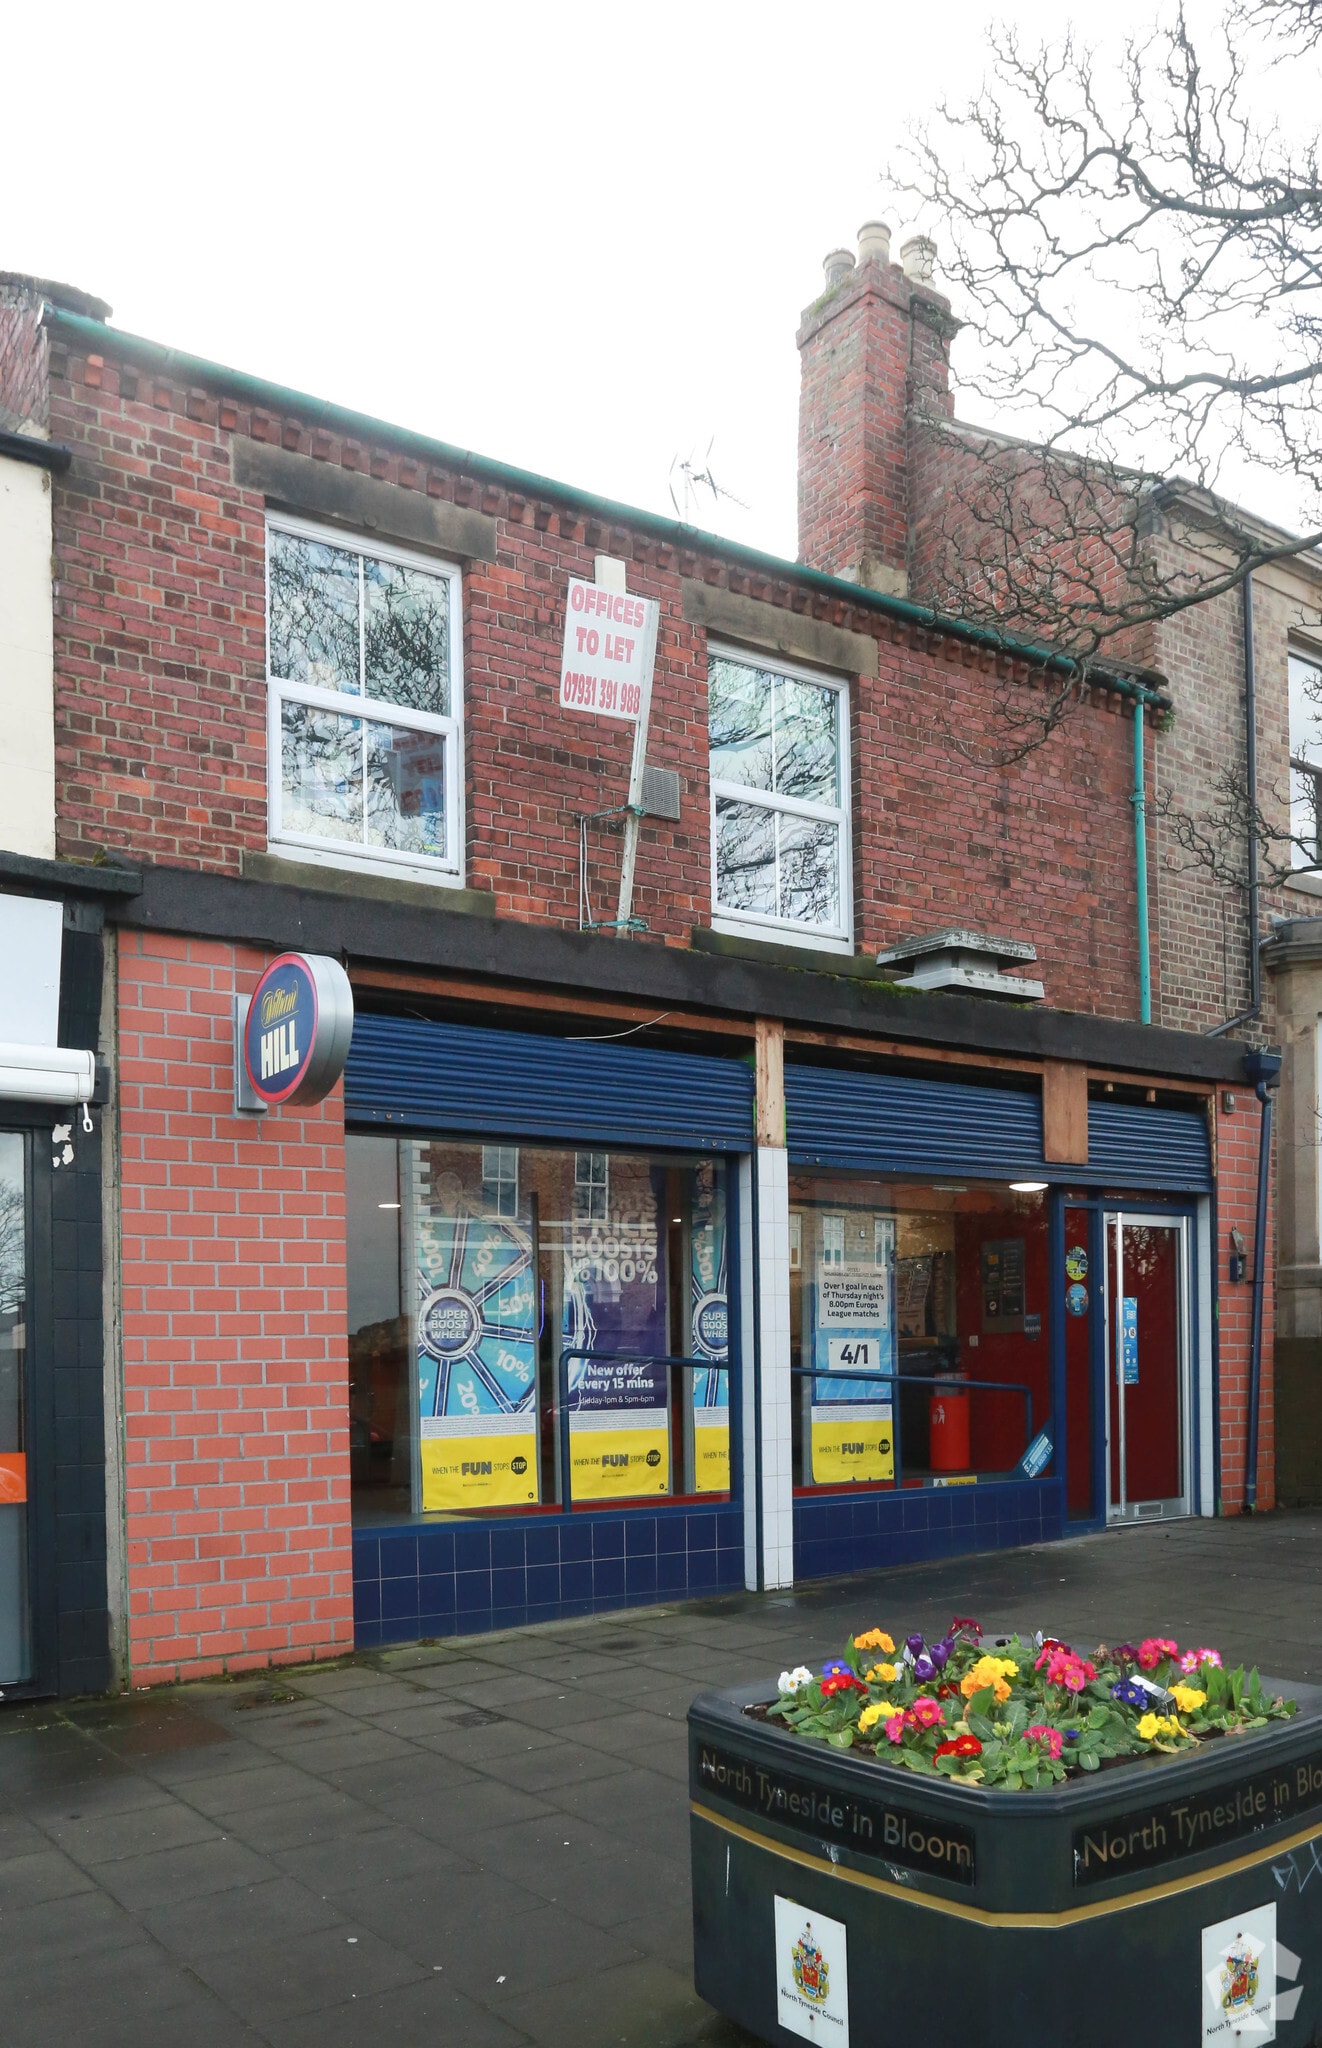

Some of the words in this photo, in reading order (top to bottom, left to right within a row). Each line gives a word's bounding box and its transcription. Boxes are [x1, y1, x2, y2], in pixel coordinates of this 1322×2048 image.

[571, 585, 644, 628] OFFICES
[576, 626, 599, 656] TO
[604, 634, 635, 663] LET
[563, 671, 596, 706] 07931
[599, 679, 618, 710] 391
[620, 683, 640, 714] 988
[261, 1019, 299, 1080] HILL
[572, 1209, 657, 1238] PRICE
[572, 1236, 657, 1260] BOOSTS
[694, 1231, 714, 1283] 100%
[593, 1259, 658, 1284] 100%
[823, 1282, 840, 1290] Over
[845, 1283, 860, 1291] goal
[831, 1291, 862, 1300] Thursday
[863, 1293, 885, 1301] night's
[828, 1300, 855, 1308] 8.00pm
[855, 1301, 878, 1309] Europa
[431, 1309, 468, 1319] SUPER
[702, 1312, 727, 1321] SUPE
[827, 1310, 852, 1318] League
[431, 1320, 468, 1329] BOOST
[703, 1321, 728, 1330] BOOS
[431, 1330, 468, 1339] WHEEL
[703, 1330, 728, 1338] WHEE
[840, 1344, 868, 1364] 4/1
[496, 1349, 530, 1383] 10%
[588, 1364, 614, 1376] New
[616, 1363, 643, 1376] offer
[578, 1379, 610, 1392] every
[612, 1377, 624, 1389] 15
[626, 1377, 655, 1389] mins
[624, 1395, 655, 1404] 5pm-6pm
[703, 1451, 718, 1459] WHEN
[718, 1450, 727, 1458] THE
[841, 1442, 864, 1455] FUN
[573, 1458, 589, 1466] WHEN
[590, 1457, 600, 1466] THE
[602, 1453, 629, 1468] FUN
[630, 1455, 646, 1464] STOPS
[647, 1454, 661, 1463] STOP
[432, 1466, 448, 1475] WHEN
[450, 1465, 460, 1474] THE
[461, 1461, 492, 1476] FUN
[493, 1462, 510, 1471] STOPS
[511, 1461, 527, 1470] STOP
[702, 1749, 752, 1795] North
[756, 1771, 844, 1828] Tyneside
[853, 1805, 873, 1838] in
[884, 1812, 971, 1868] Bloom
[1083, 1817, 1167, 1867] North
[1171, 1786, 1267, 1847] Tyneside
[1273, 1779, 1290, 1806] in
[1297, 1763, 1322, 1798] Blo
[780, 1987, 798, 2003] North
[797, 1997, 822, 2015] Tyneside
[821, 2009, 844, 2027] Council
[1206, 2022, 1225, 2036] North
[1250, 2002, 1272, 2016] Council
